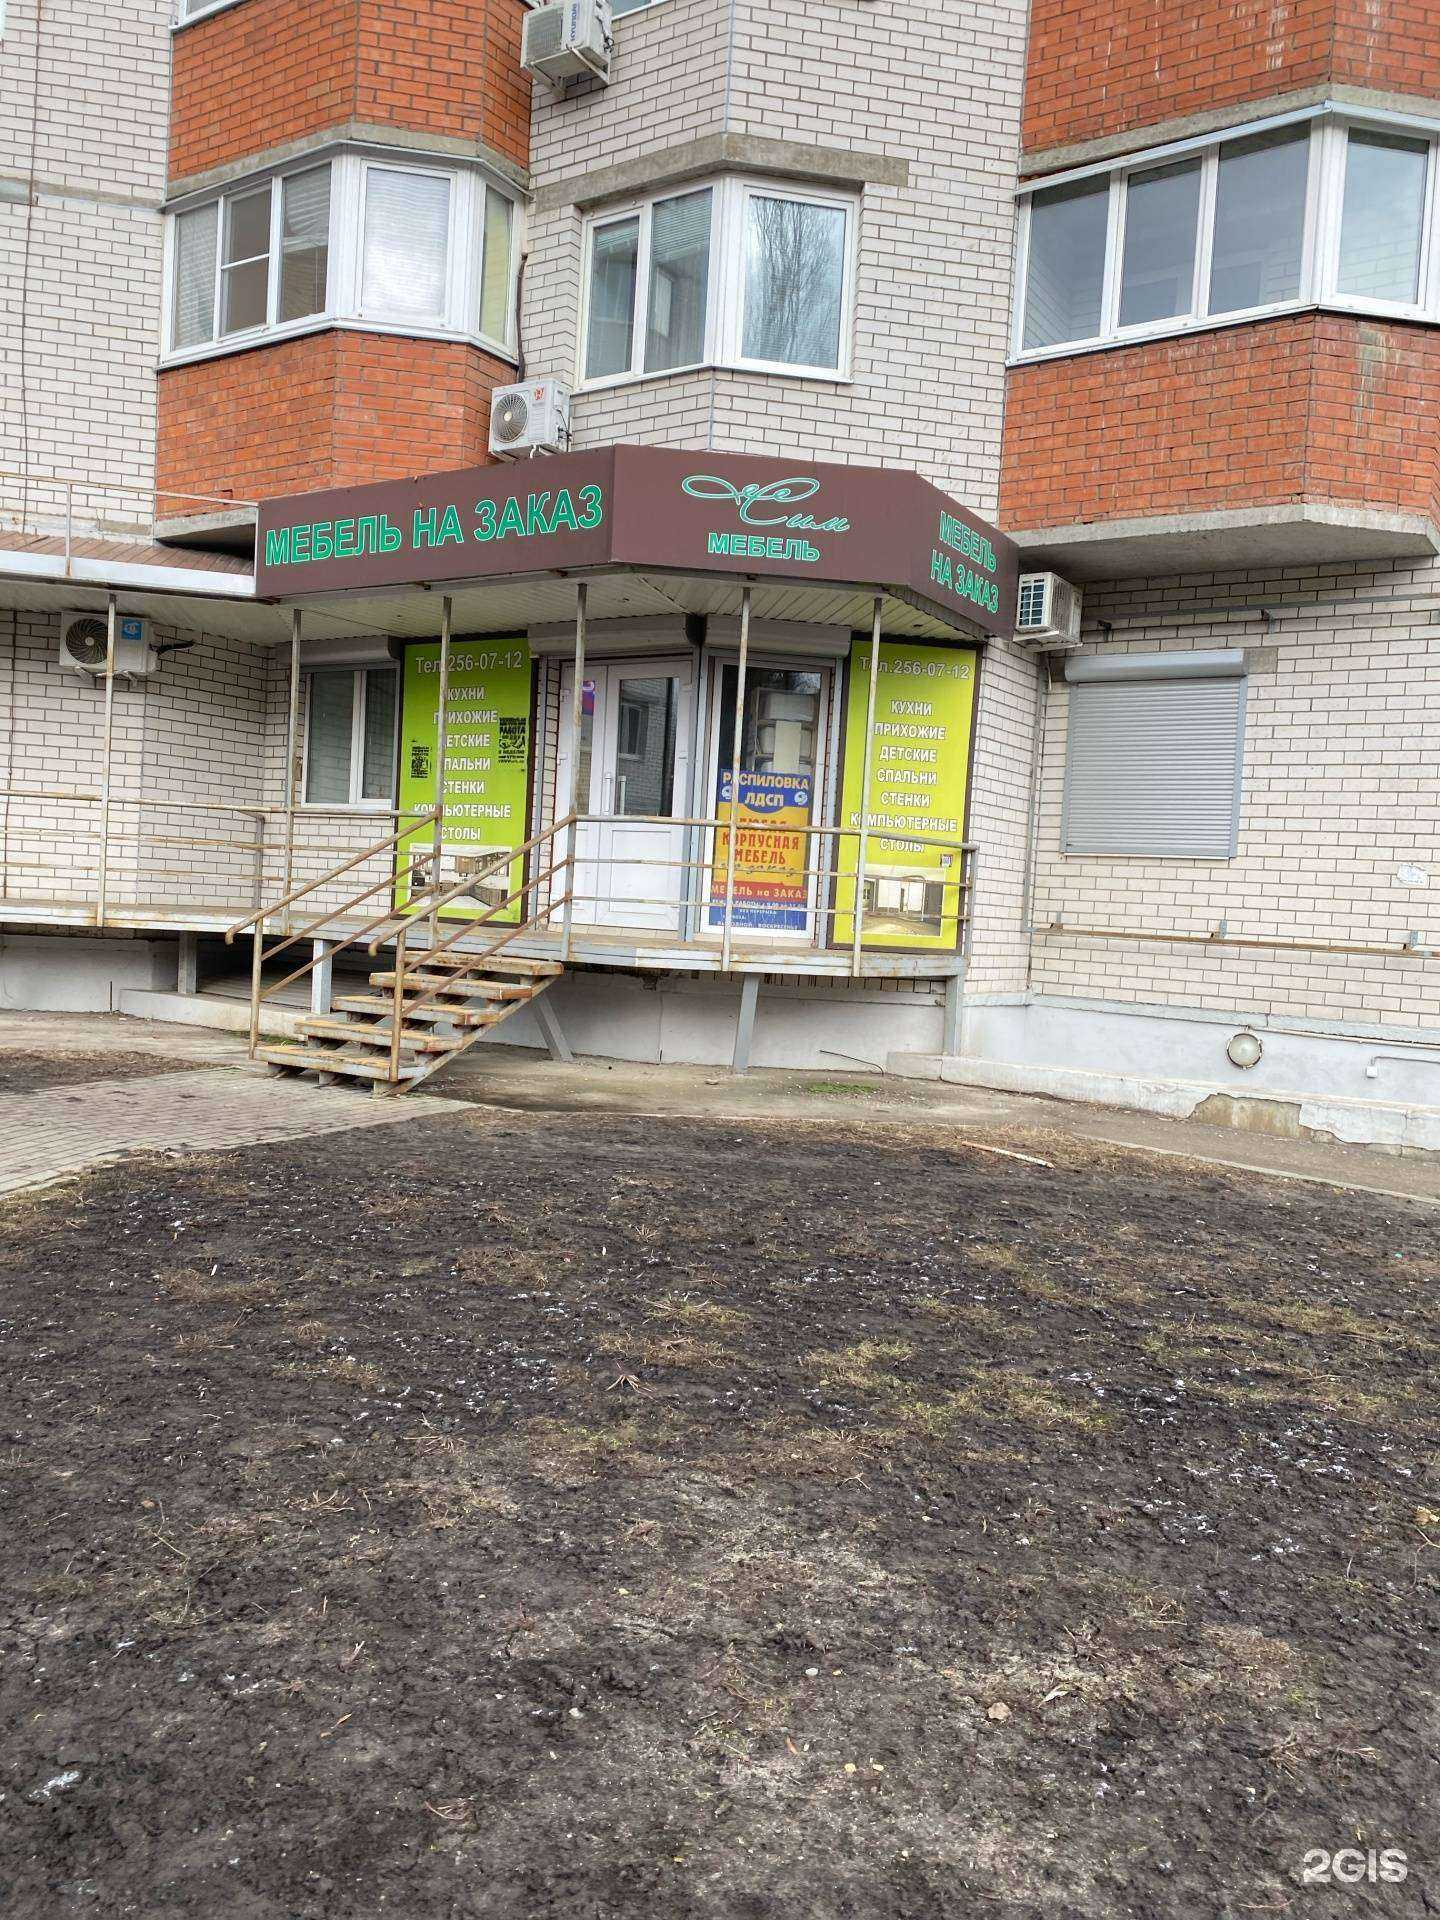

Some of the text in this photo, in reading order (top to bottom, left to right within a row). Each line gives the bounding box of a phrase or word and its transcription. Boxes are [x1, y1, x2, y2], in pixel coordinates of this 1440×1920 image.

[265, 485, 603, 566] МЕБЕЛЬ НА ЗАКАЗ
[708, 532, 821, 562] МЕБЕЛЬ
[939, 510, 997, 573] МЕБЕЛЬ
[931, 549, 999, 614] НА ЗАКАЗ
[860, 656, 970, 679] Тл.256-07-12
[447, 687, 485, 701] КУХНИ
[891, 700, 932, 716] КУХНИ
[433, 710, 498, 724] ПИХОЖИЕ
[874, 723, 946, 740] ПРИХОЖИЕ
[445, 734, 490, 748] ЕТСКИЕ
[880, 746, 937, 763] ДЕТСКИЕ
[443, 757, 490, 770] ПАЛЬНИ
[723, 772, 809, 789] РСПИЛОВКА
[877, 768, 937, 785] СПАЛЬНИ
[745, 791, 784, 807] ЛДСП
[881, 792, 931, 807] СТЕНКИ
[414, 803, 511, 818] КОМЬЮТЕРНЫЕ
[850, 812, 957, 832] КМПЬЮТЕРНЫЕ
[441, 826, 481, 840] СТОЛЫ
[735, 848, 786, 865] МЕБЕЛЬ
[712, 884, 752, 896] МЕЕЛЬ
